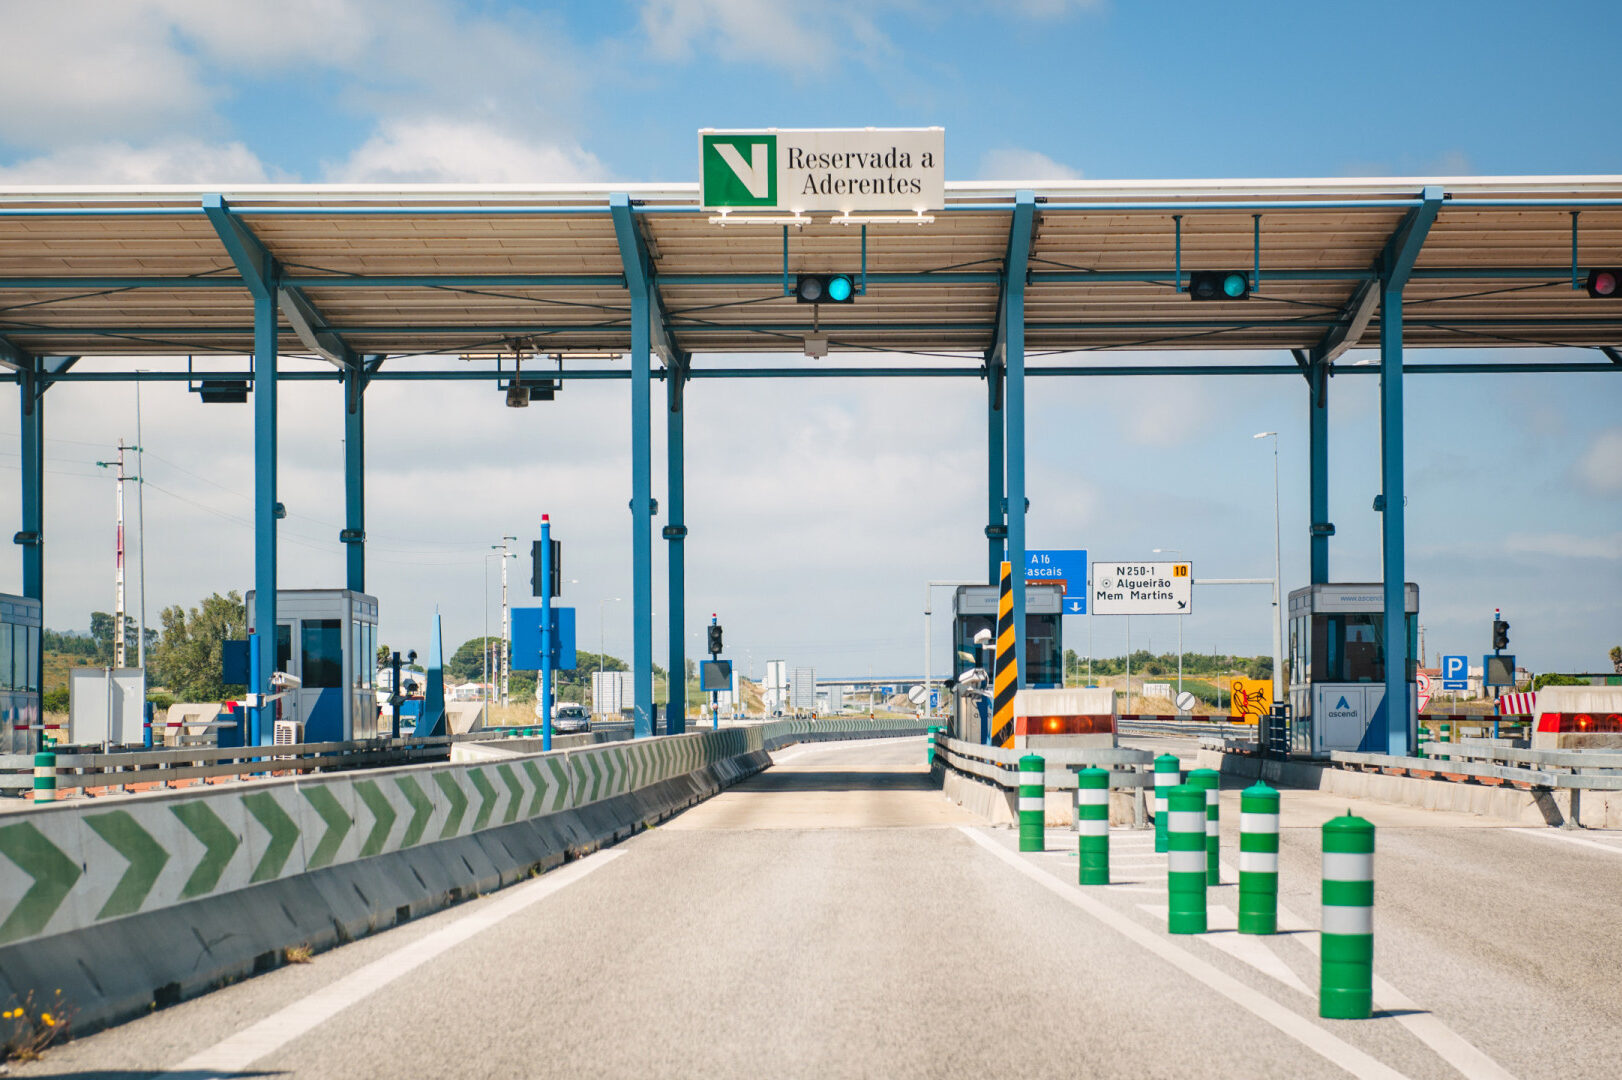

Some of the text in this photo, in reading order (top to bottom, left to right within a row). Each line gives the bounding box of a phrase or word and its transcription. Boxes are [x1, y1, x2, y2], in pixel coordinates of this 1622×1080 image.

[787, 147, 935, 169] Reservada a
[801, 173, 922, 195] Aderentes
[1025, 566, 1063, 577] ascais
[1175, 565, 1187, 577] 10
[1116, 578, 1171, 590] Algueirão
[1096, 590, 1174, 601] Mem Martins
[1448, 657, 1463, 679] P
[1328, 710, 1358, 718] ascendi
